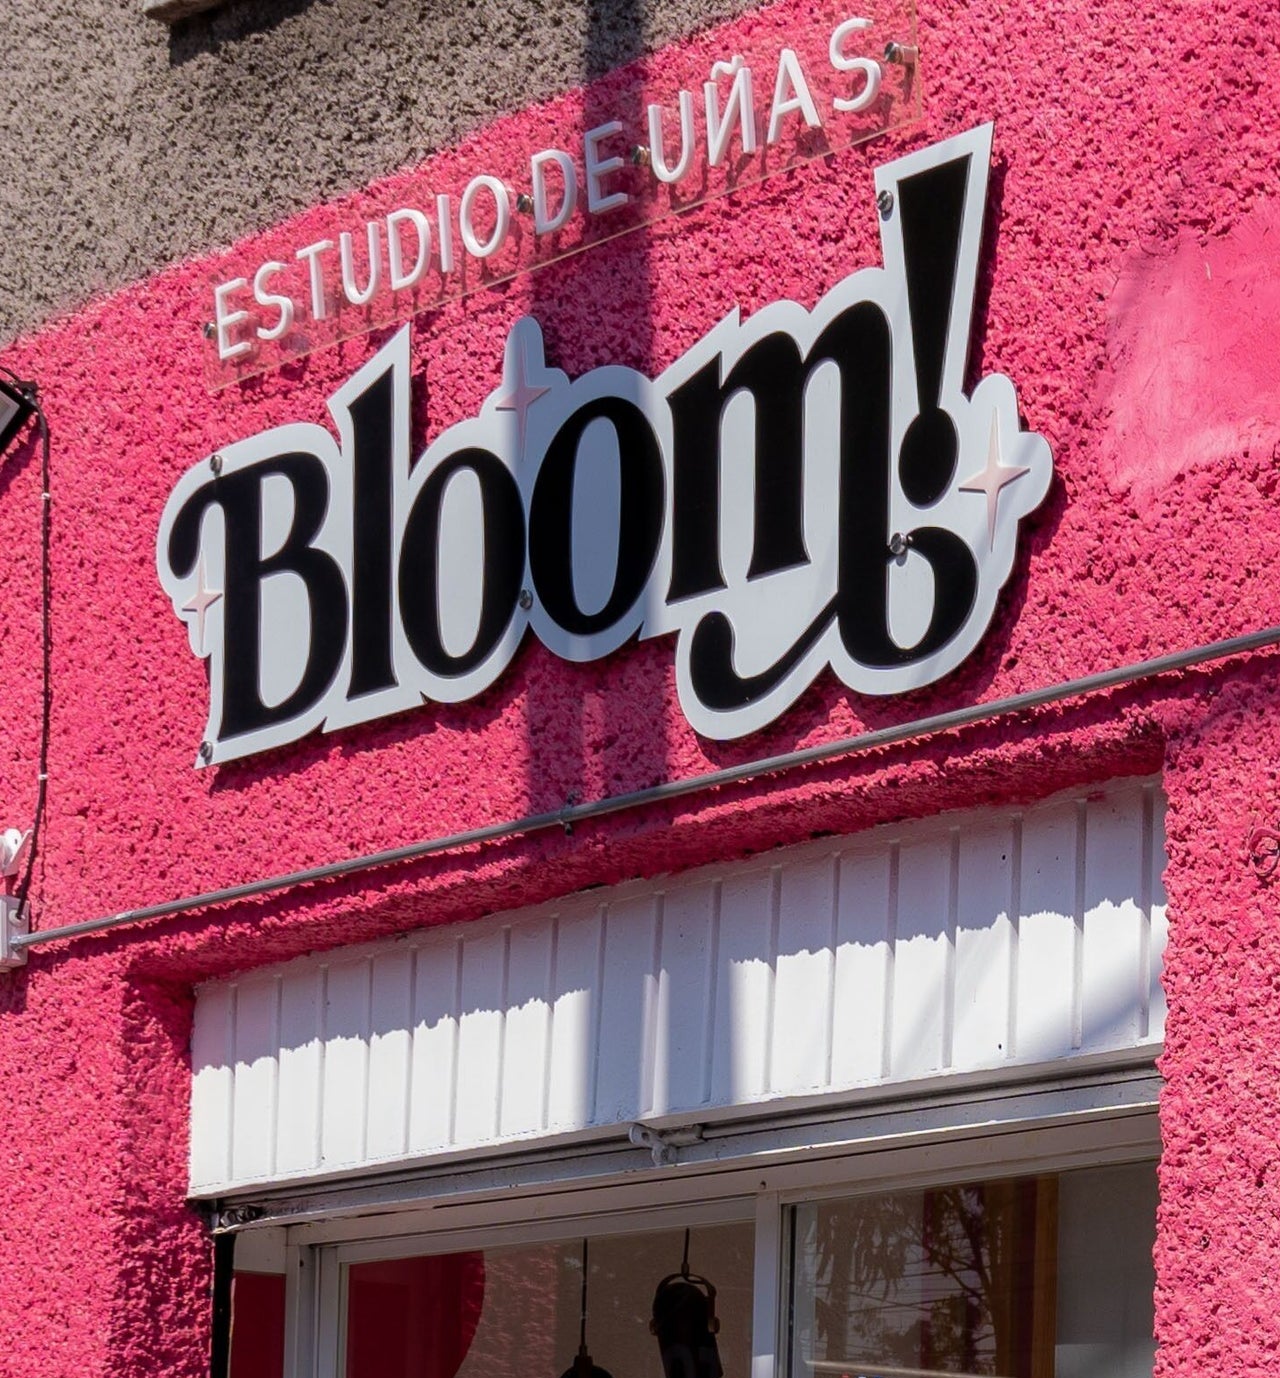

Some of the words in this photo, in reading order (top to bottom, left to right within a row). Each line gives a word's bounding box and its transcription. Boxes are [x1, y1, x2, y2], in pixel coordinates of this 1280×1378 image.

[213, 174, 510, 362] ESTUDIO
[531, 119, 626, 237] DE
[647, 17, 882, 186] UÑAS
[166, 150, 980, 743] Bloom!
